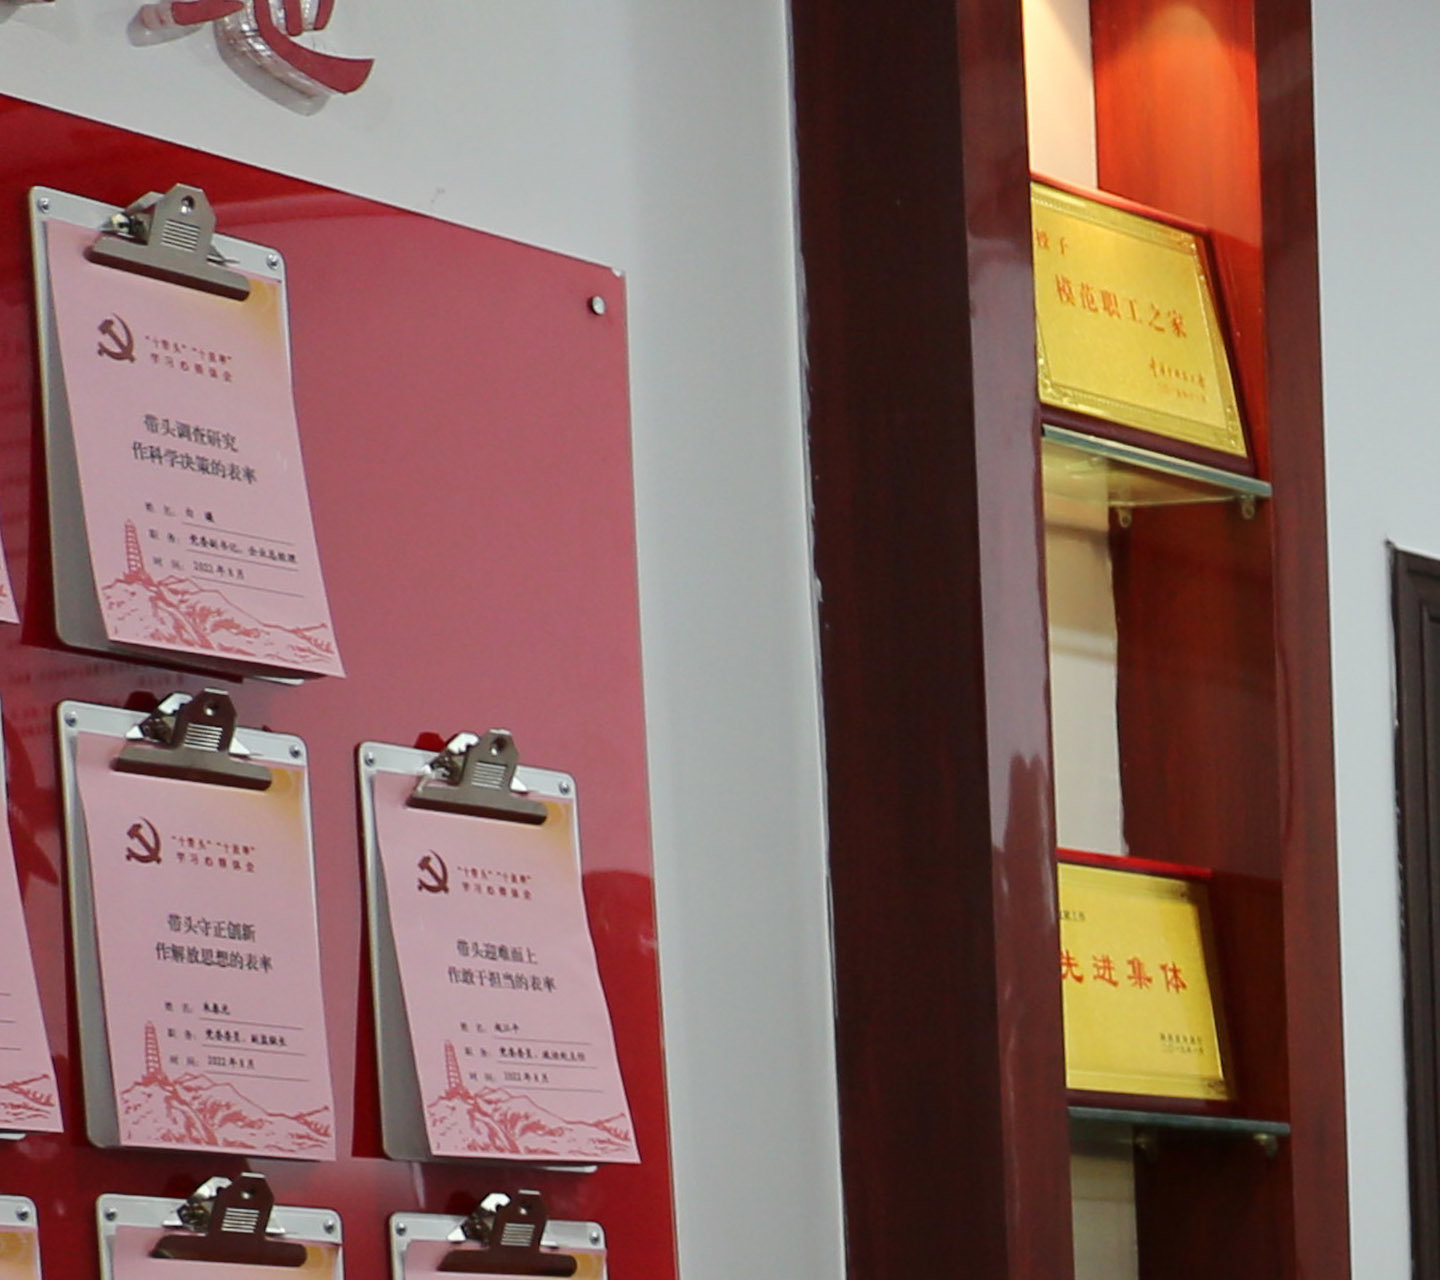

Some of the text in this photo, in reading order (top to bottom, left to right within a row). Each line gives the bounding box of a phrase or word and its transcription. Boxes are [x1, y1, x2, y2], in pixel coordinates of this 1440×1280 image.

[1055, 273, 1188, 339] 模范职工之家
[144, 413, 239, 452] 带头调查研究
[132, 441, 257, 484] 作科学决策的表率
[167, 914, 256, 942] 带头守正创新
[155, 942, 273, 973] 作解放思想的表率
[457, 939, 538, 965] 带头迎难而上
[448, 966, 556, 993] 作敢于担当的表率
[1059, 950, 1188, 994] 先进集体
